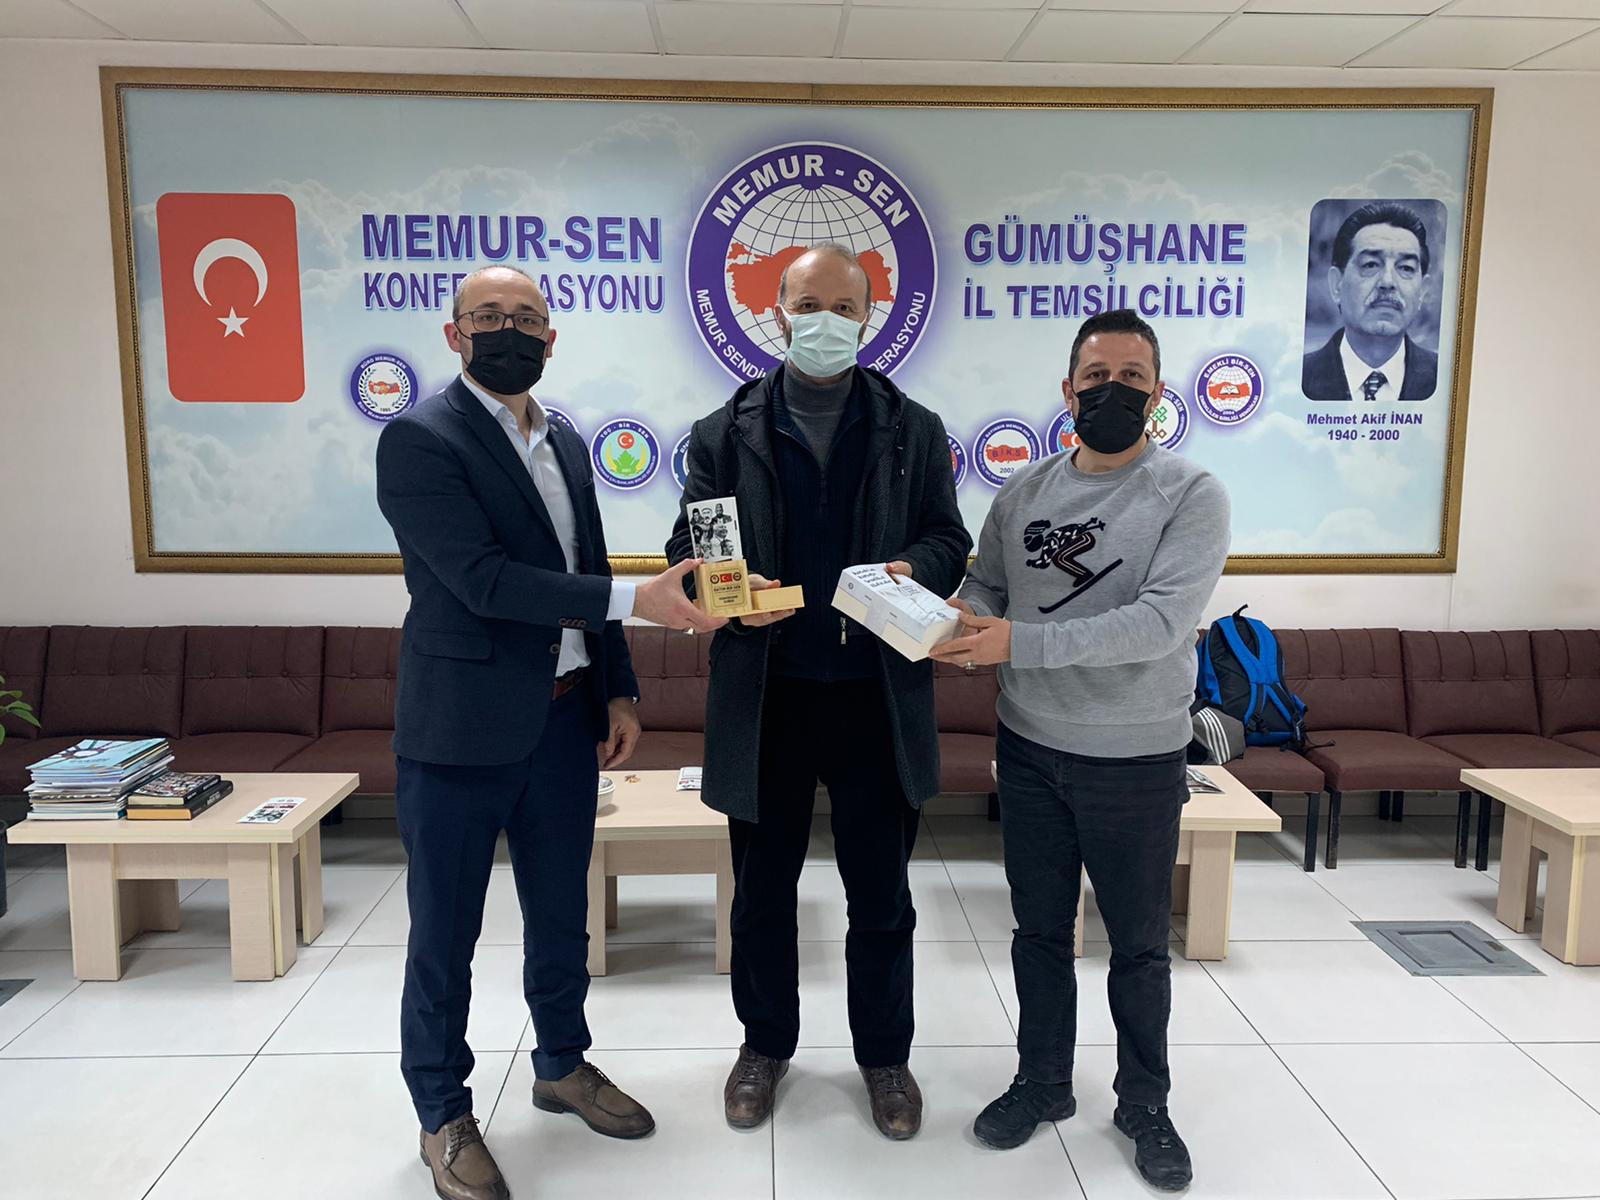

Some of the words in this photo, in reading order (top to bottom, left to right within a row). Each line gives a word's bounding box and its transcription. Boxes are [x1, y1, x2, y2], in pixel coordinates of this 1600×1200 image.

[712, 154, 824, 226] MEMUR
[853, 169, 911, 227] SEN
[361, 214, 661, 261] MEMUR-SEN
[963, 214, 1246, 274] GÜMÜŞHANE
[363, 271, 664, 312] KONFASYONU
[963, 277, 994, 317] İL
[696, 289, 727, 347] MEMUR
[1307, 413, 1357, 425] Mehmet
[1361, 413, 1386, 425] Akif
[1391, 411, 1423, 425] İNAN
[1328, 429, 1358, 441] 1940
[1369, 429, 1400, 441] 2000
